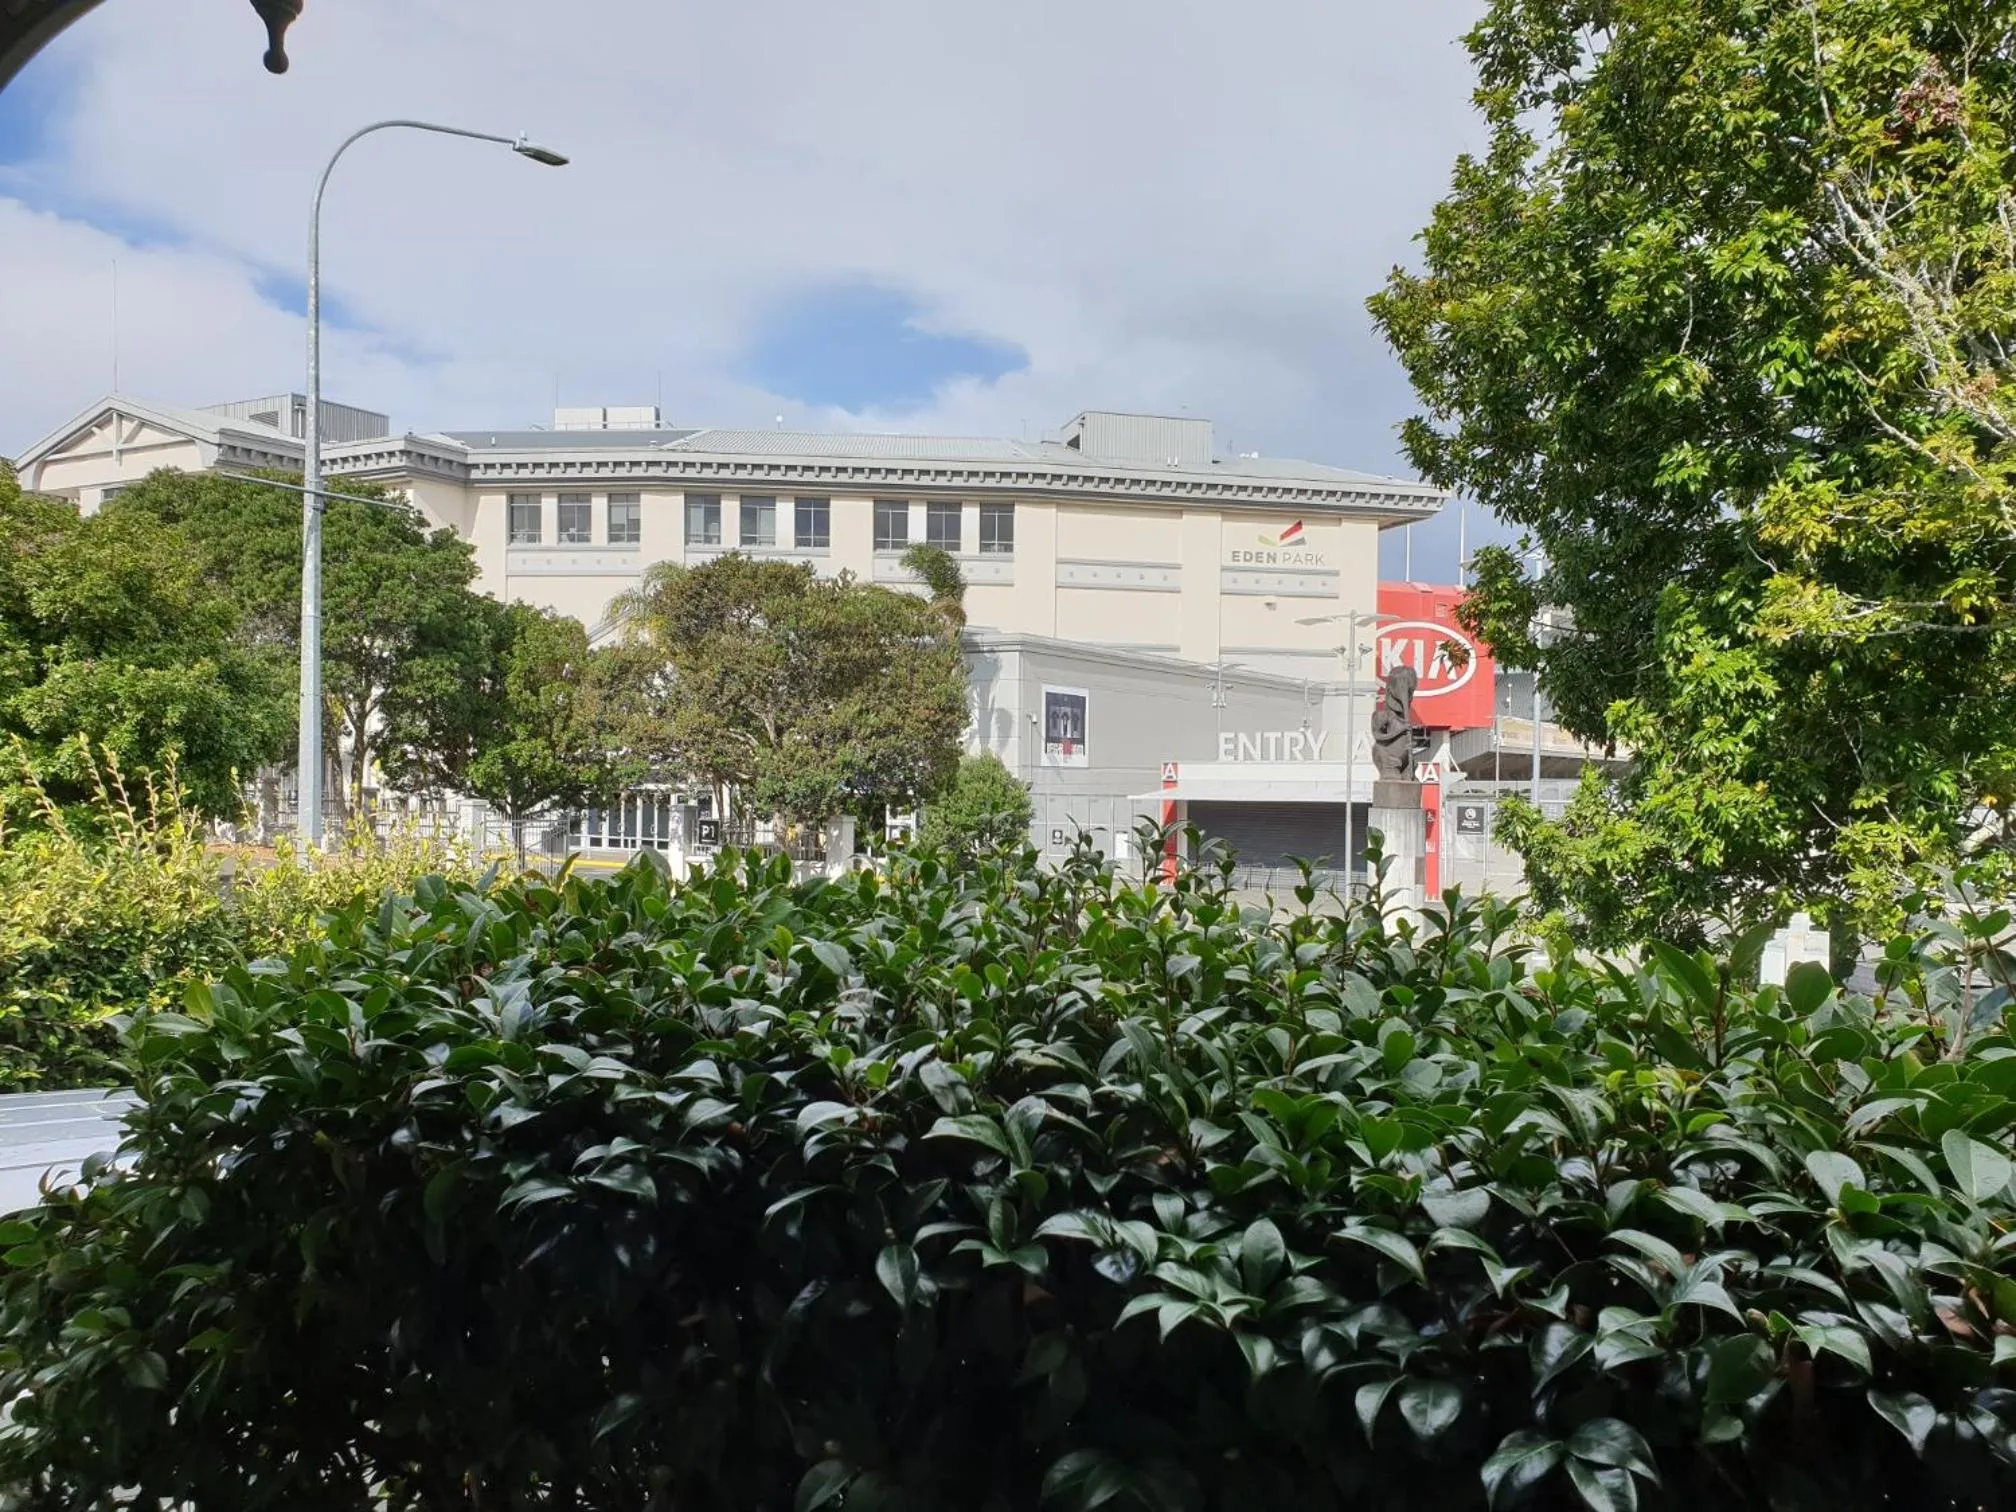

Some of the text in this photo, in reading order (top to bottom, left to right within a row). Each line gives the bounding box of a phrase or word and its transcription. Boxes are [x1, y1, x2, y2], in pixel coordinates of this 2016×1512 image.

[1232, 550, 1325, 567] EDEN PARK
[1381, 638, 1457, 680] KIA
[1218, 729, 1329, 762] ENTRY
[1161, 763, 1177, 780] A
[1421, 763, 1439, 782] A
[702, 825, 715, 838] P1
